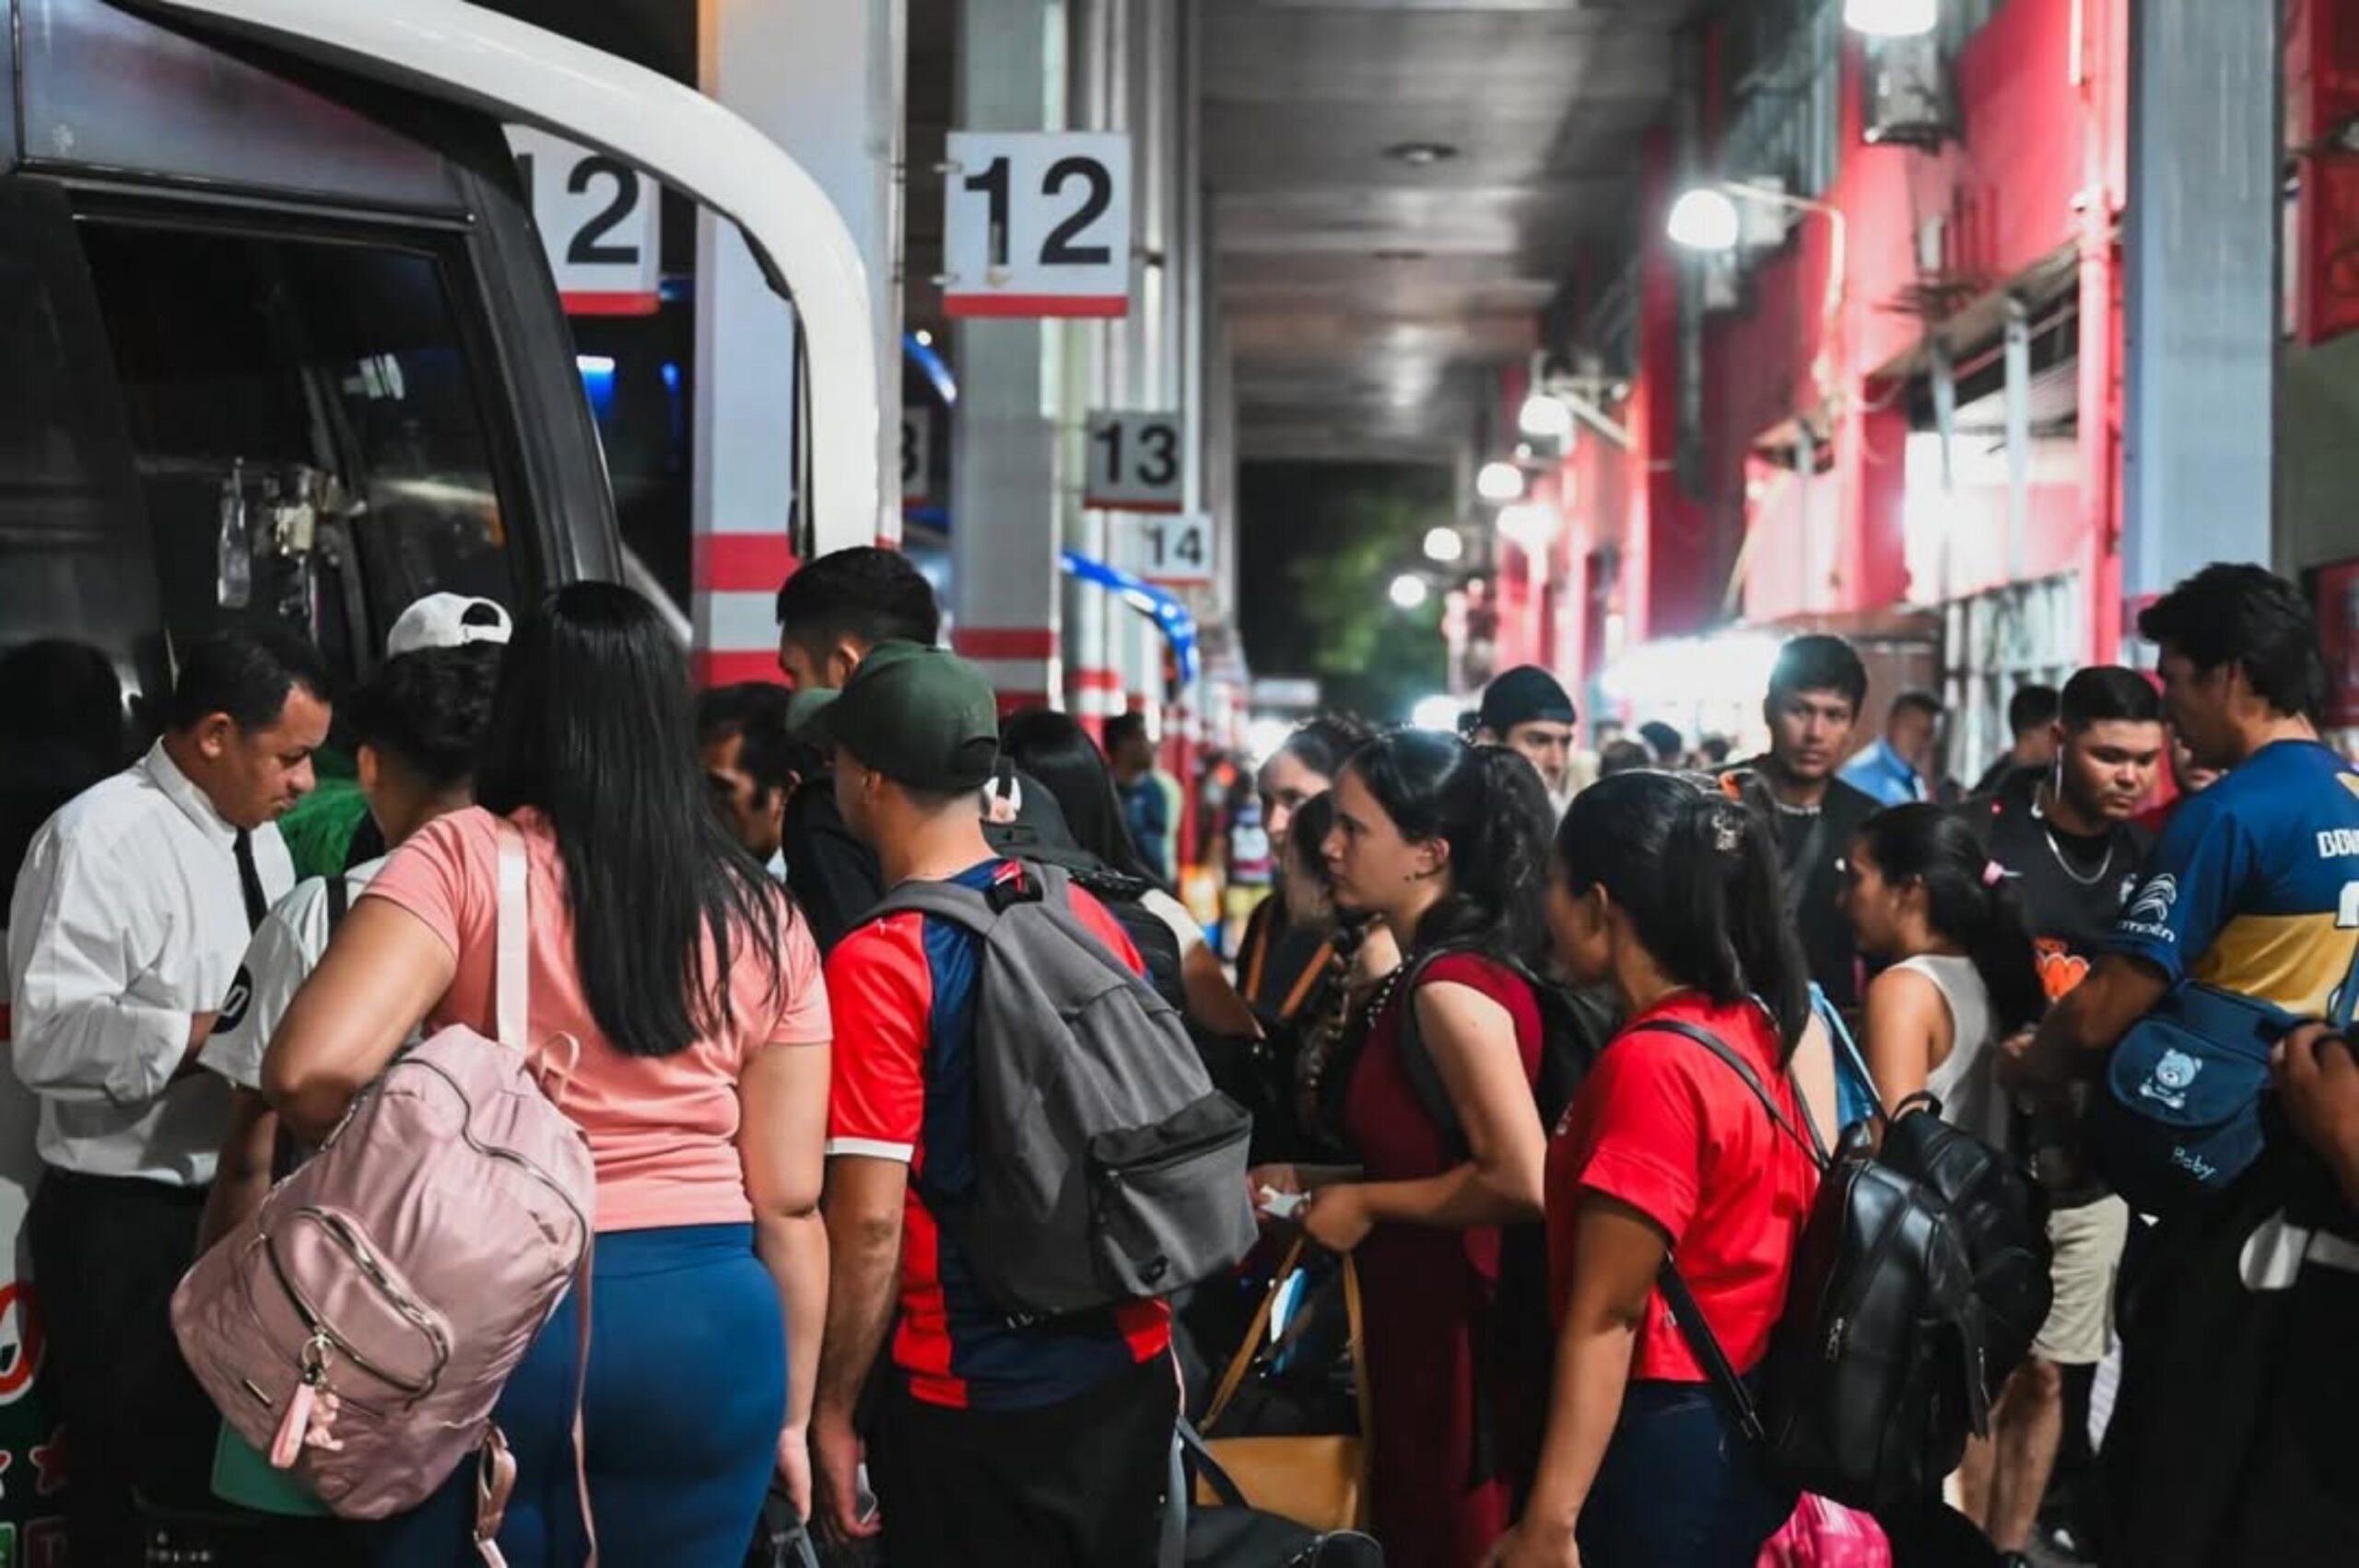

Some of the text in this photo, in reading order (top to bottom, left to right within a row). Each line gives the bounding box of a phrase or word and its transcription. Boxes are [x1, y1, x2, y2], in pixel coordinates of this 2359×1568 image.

[964, 157, 1111, 264] 12
[1094, 421, 1176, 486] 13
[1142, 526, 1202, 567] 14
[2172, 1145, 2216, 1180] Baby
